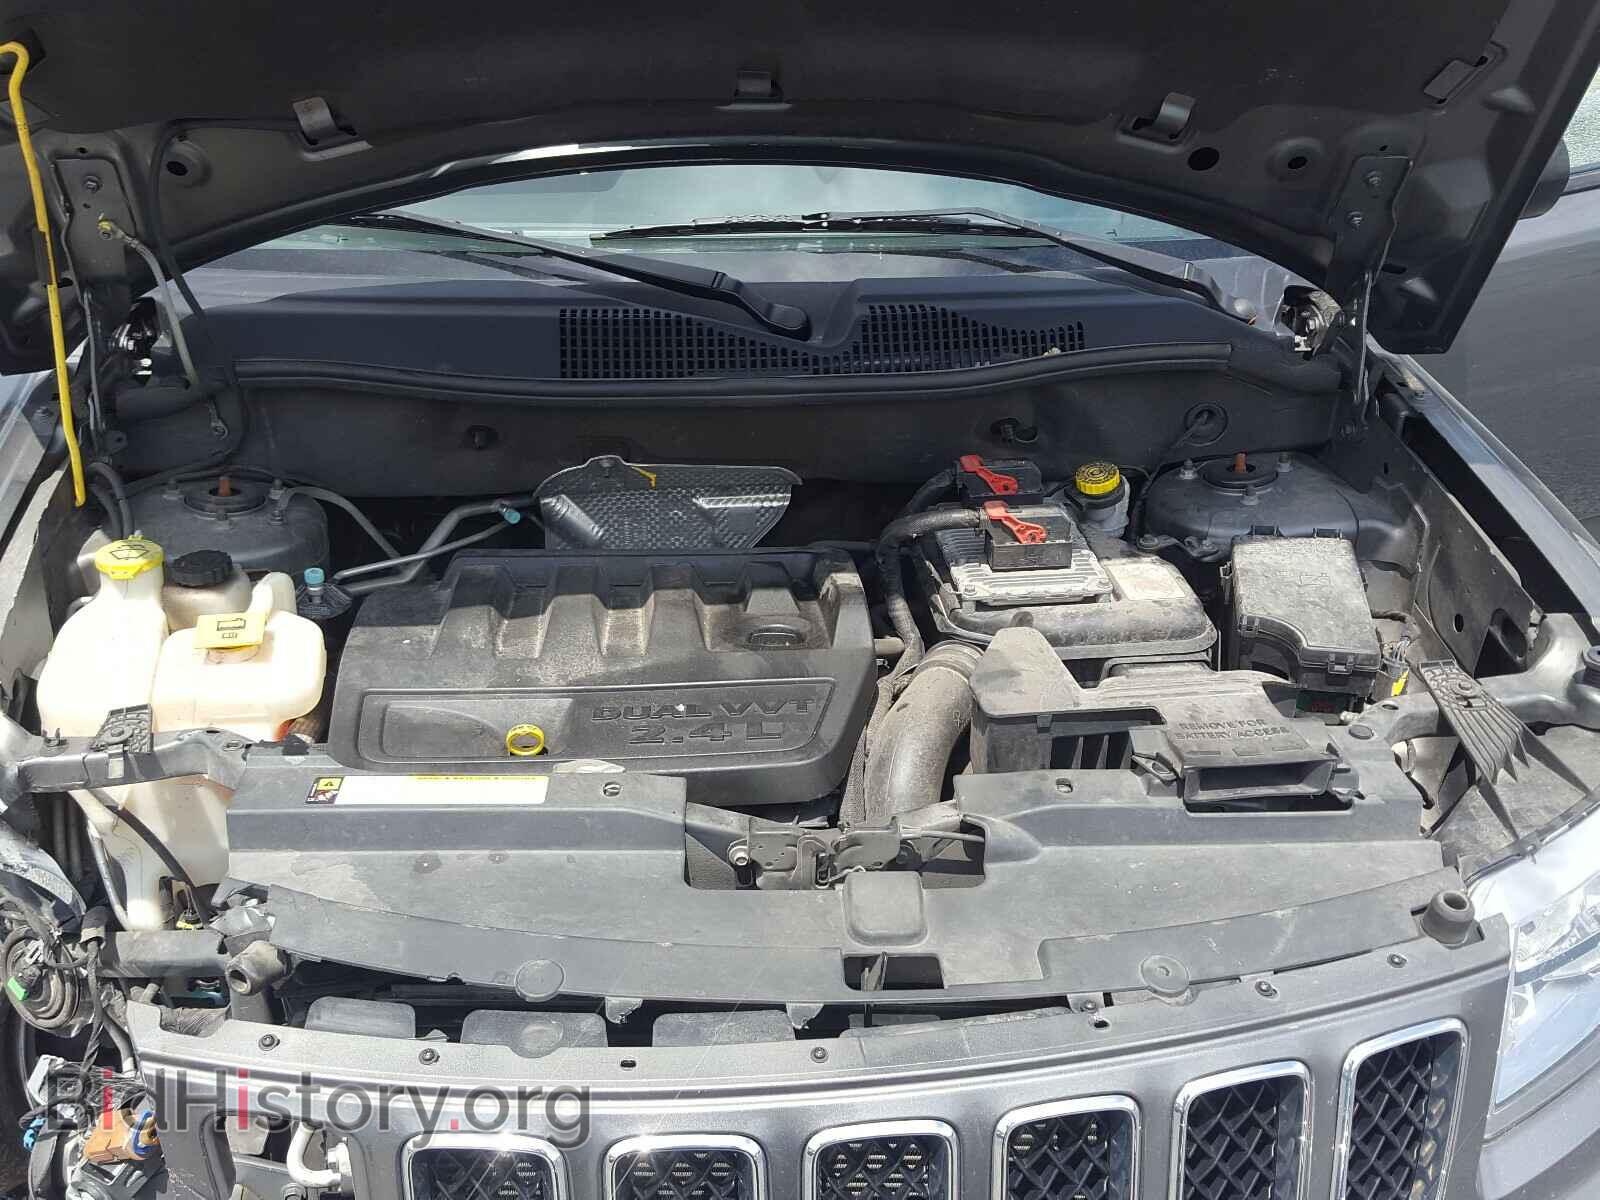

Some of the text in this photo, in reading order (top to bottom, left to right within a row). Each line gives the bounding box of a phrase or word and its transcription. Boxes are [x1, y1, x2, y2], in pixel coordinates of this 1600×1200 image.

[592, 700, 816, 721] DUAL VVT
[1178, 718, 1267, 731] REMOVE FOR
[1175, 726, 1290, 741] BATTERY ACCESS
